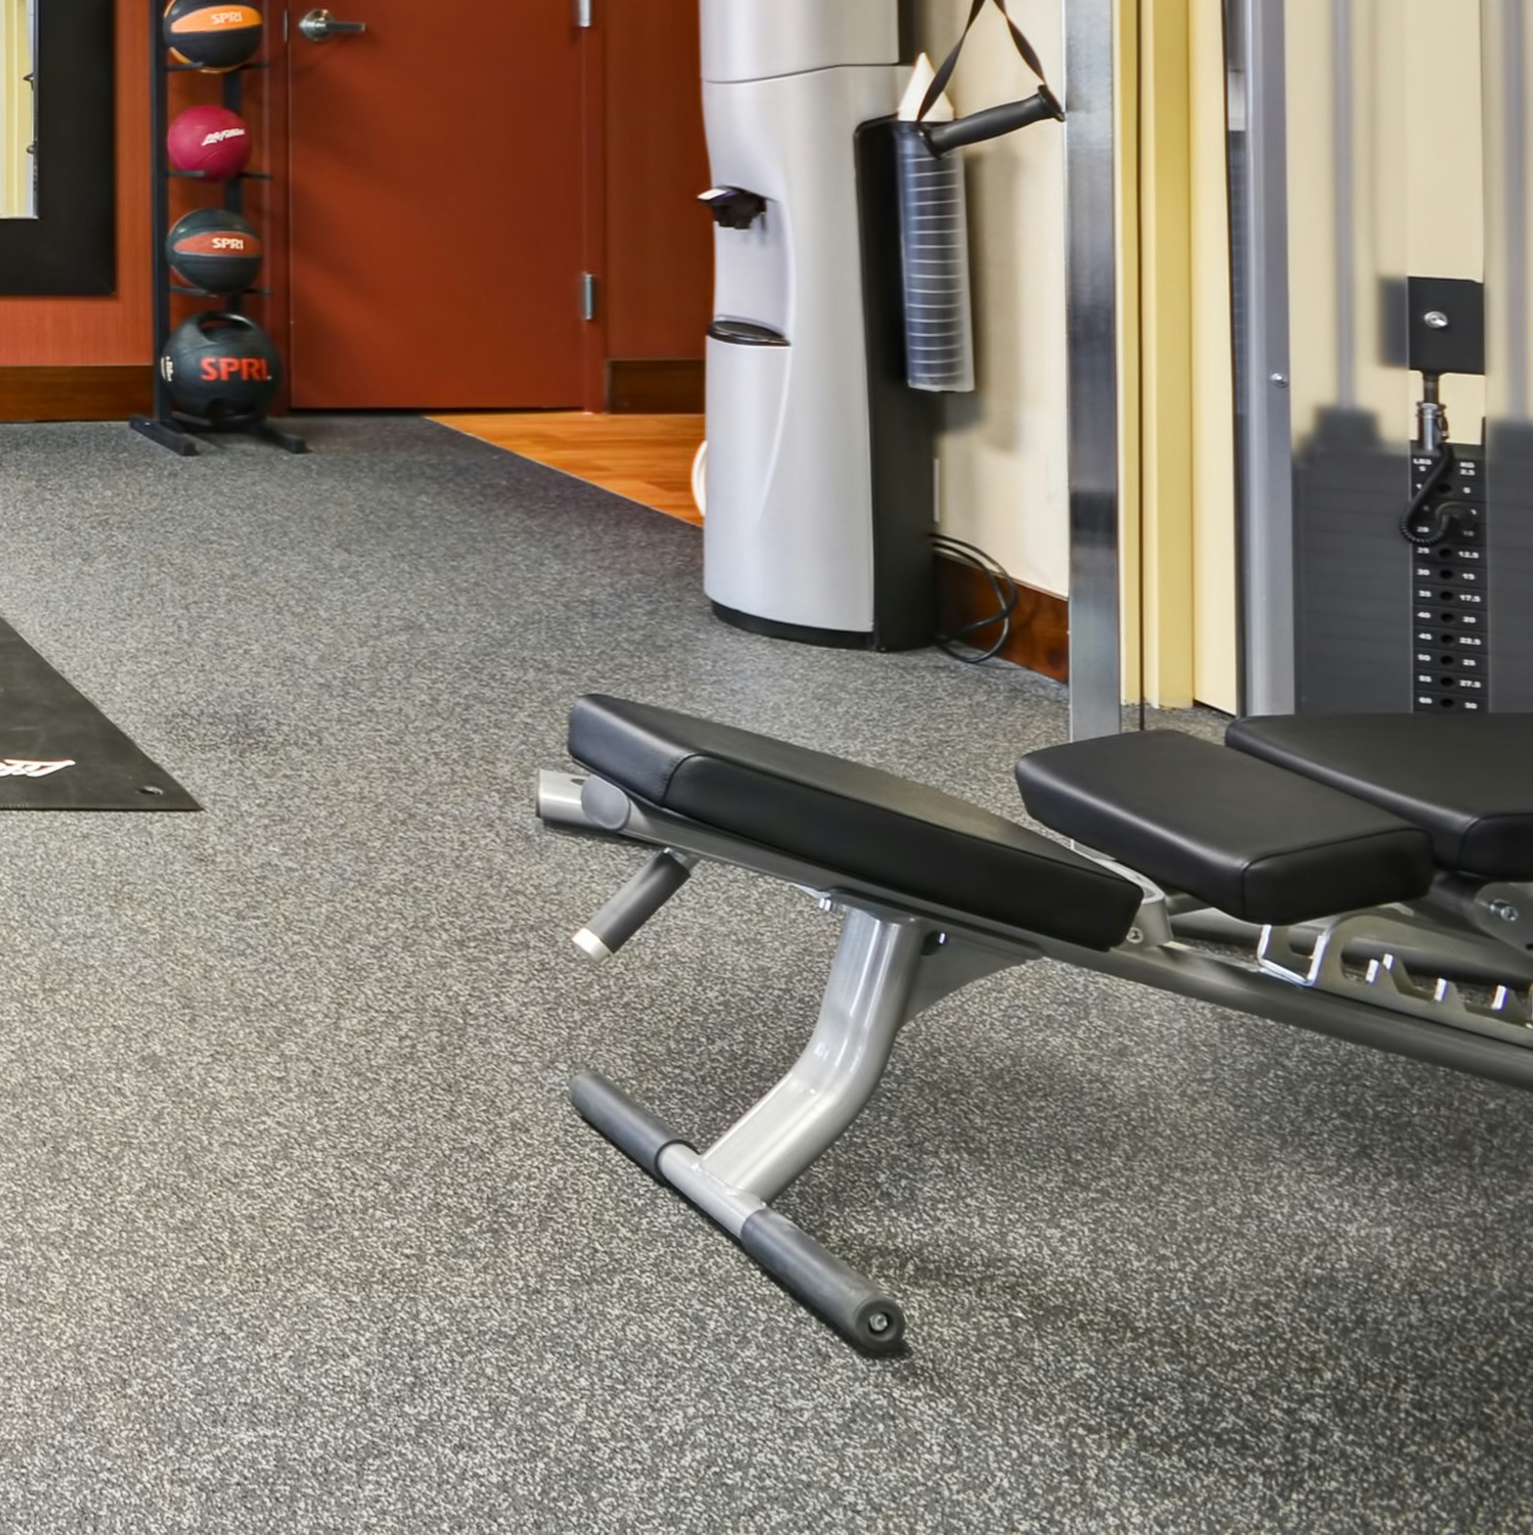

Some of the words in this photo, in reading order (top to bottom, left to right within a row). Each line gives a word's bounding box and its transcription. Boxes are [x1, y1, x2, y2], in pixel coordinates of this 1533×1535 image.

[210, 11, 243, 25] SPRI
[212, 237, 244, 251] SPRI
[199, 356, 270, 382] SPRI
